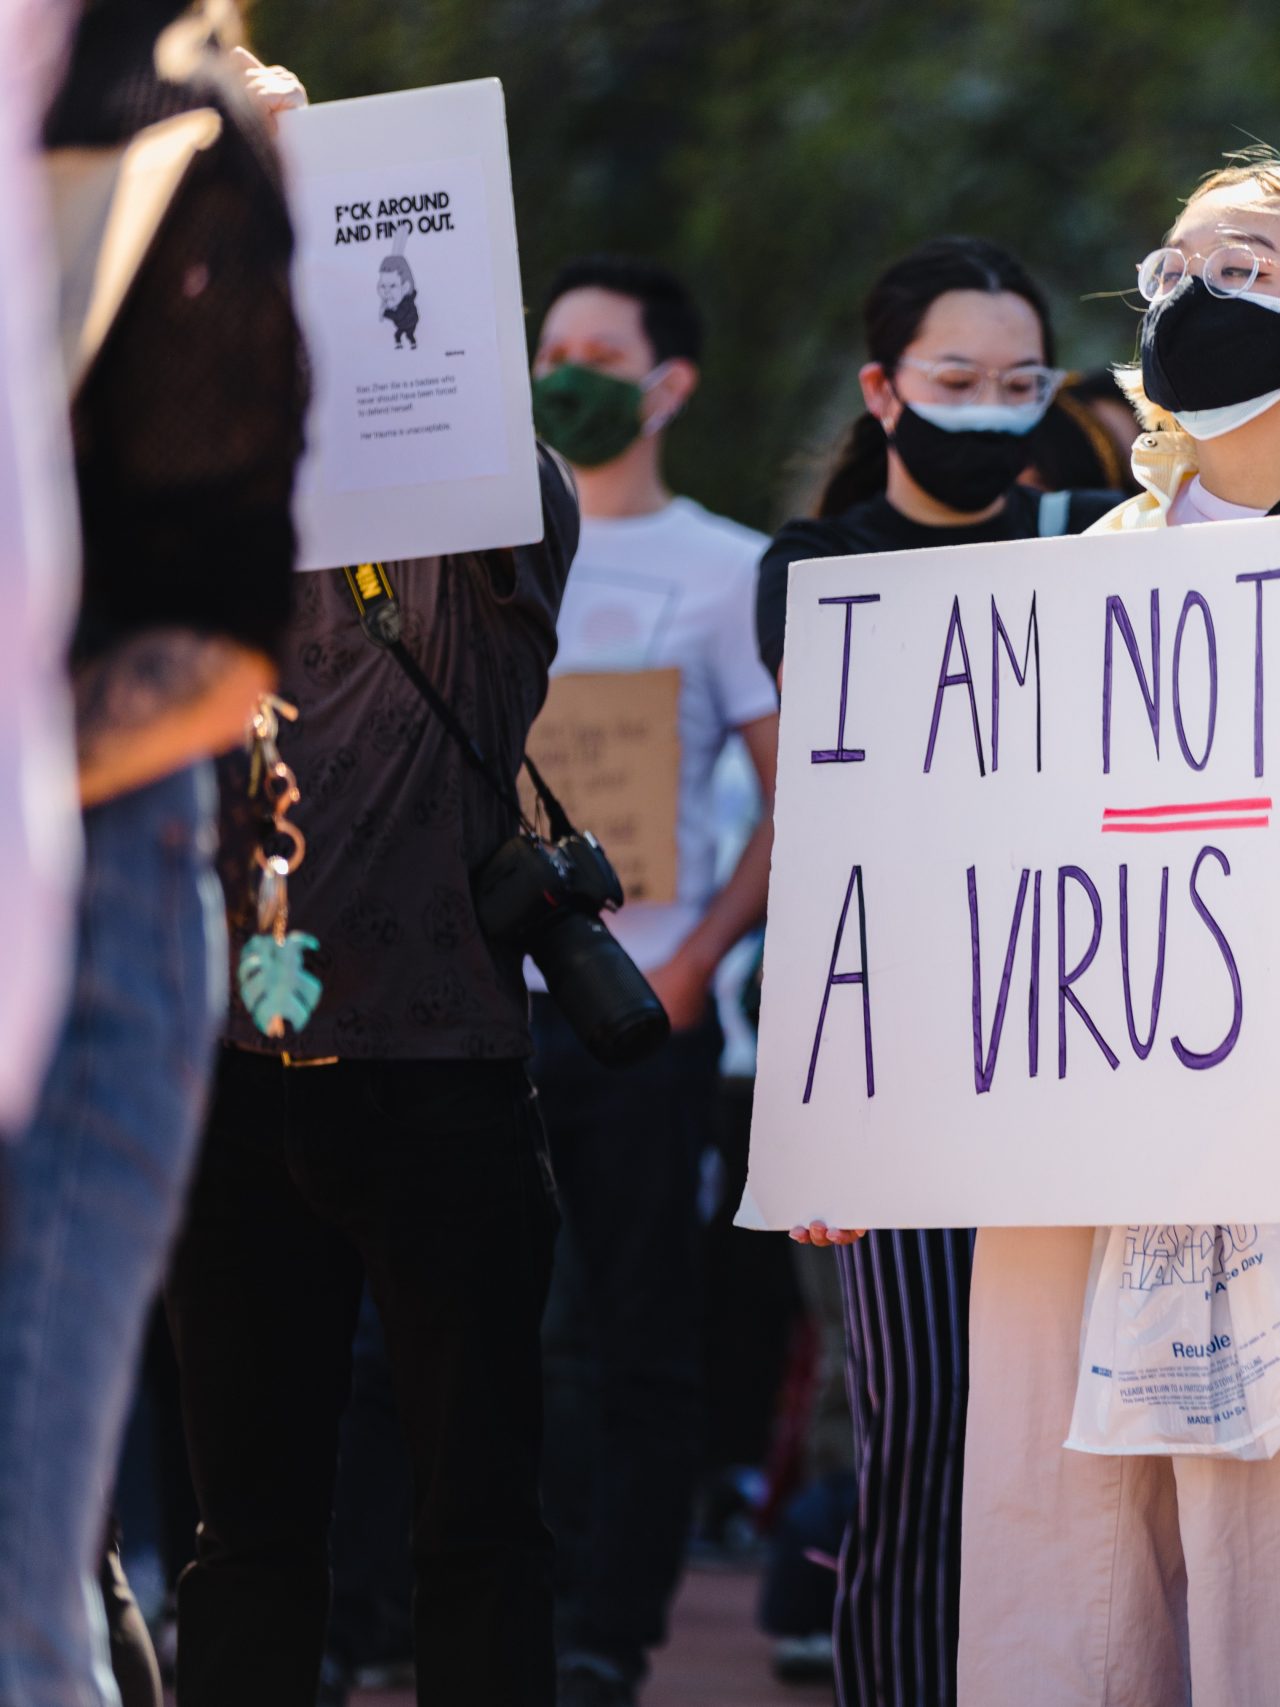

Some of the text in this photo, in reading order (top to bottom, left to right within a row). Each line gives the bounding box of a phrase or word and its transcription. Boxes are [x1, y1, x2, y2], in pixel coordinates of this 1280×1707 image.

[378, 191, 449, 217] AROUND
[335, 224, 371, 246] AND
[418, 213, 455, 234] OUT.
[811, 593, 881, 764] I
[923, 589, 1042, 778] AM
[803, 846, 1244, 1104] A VIRUS
[1241, 1253, 1264, 1272] Day
[1187, 1415, 1212, 1425] MADE
